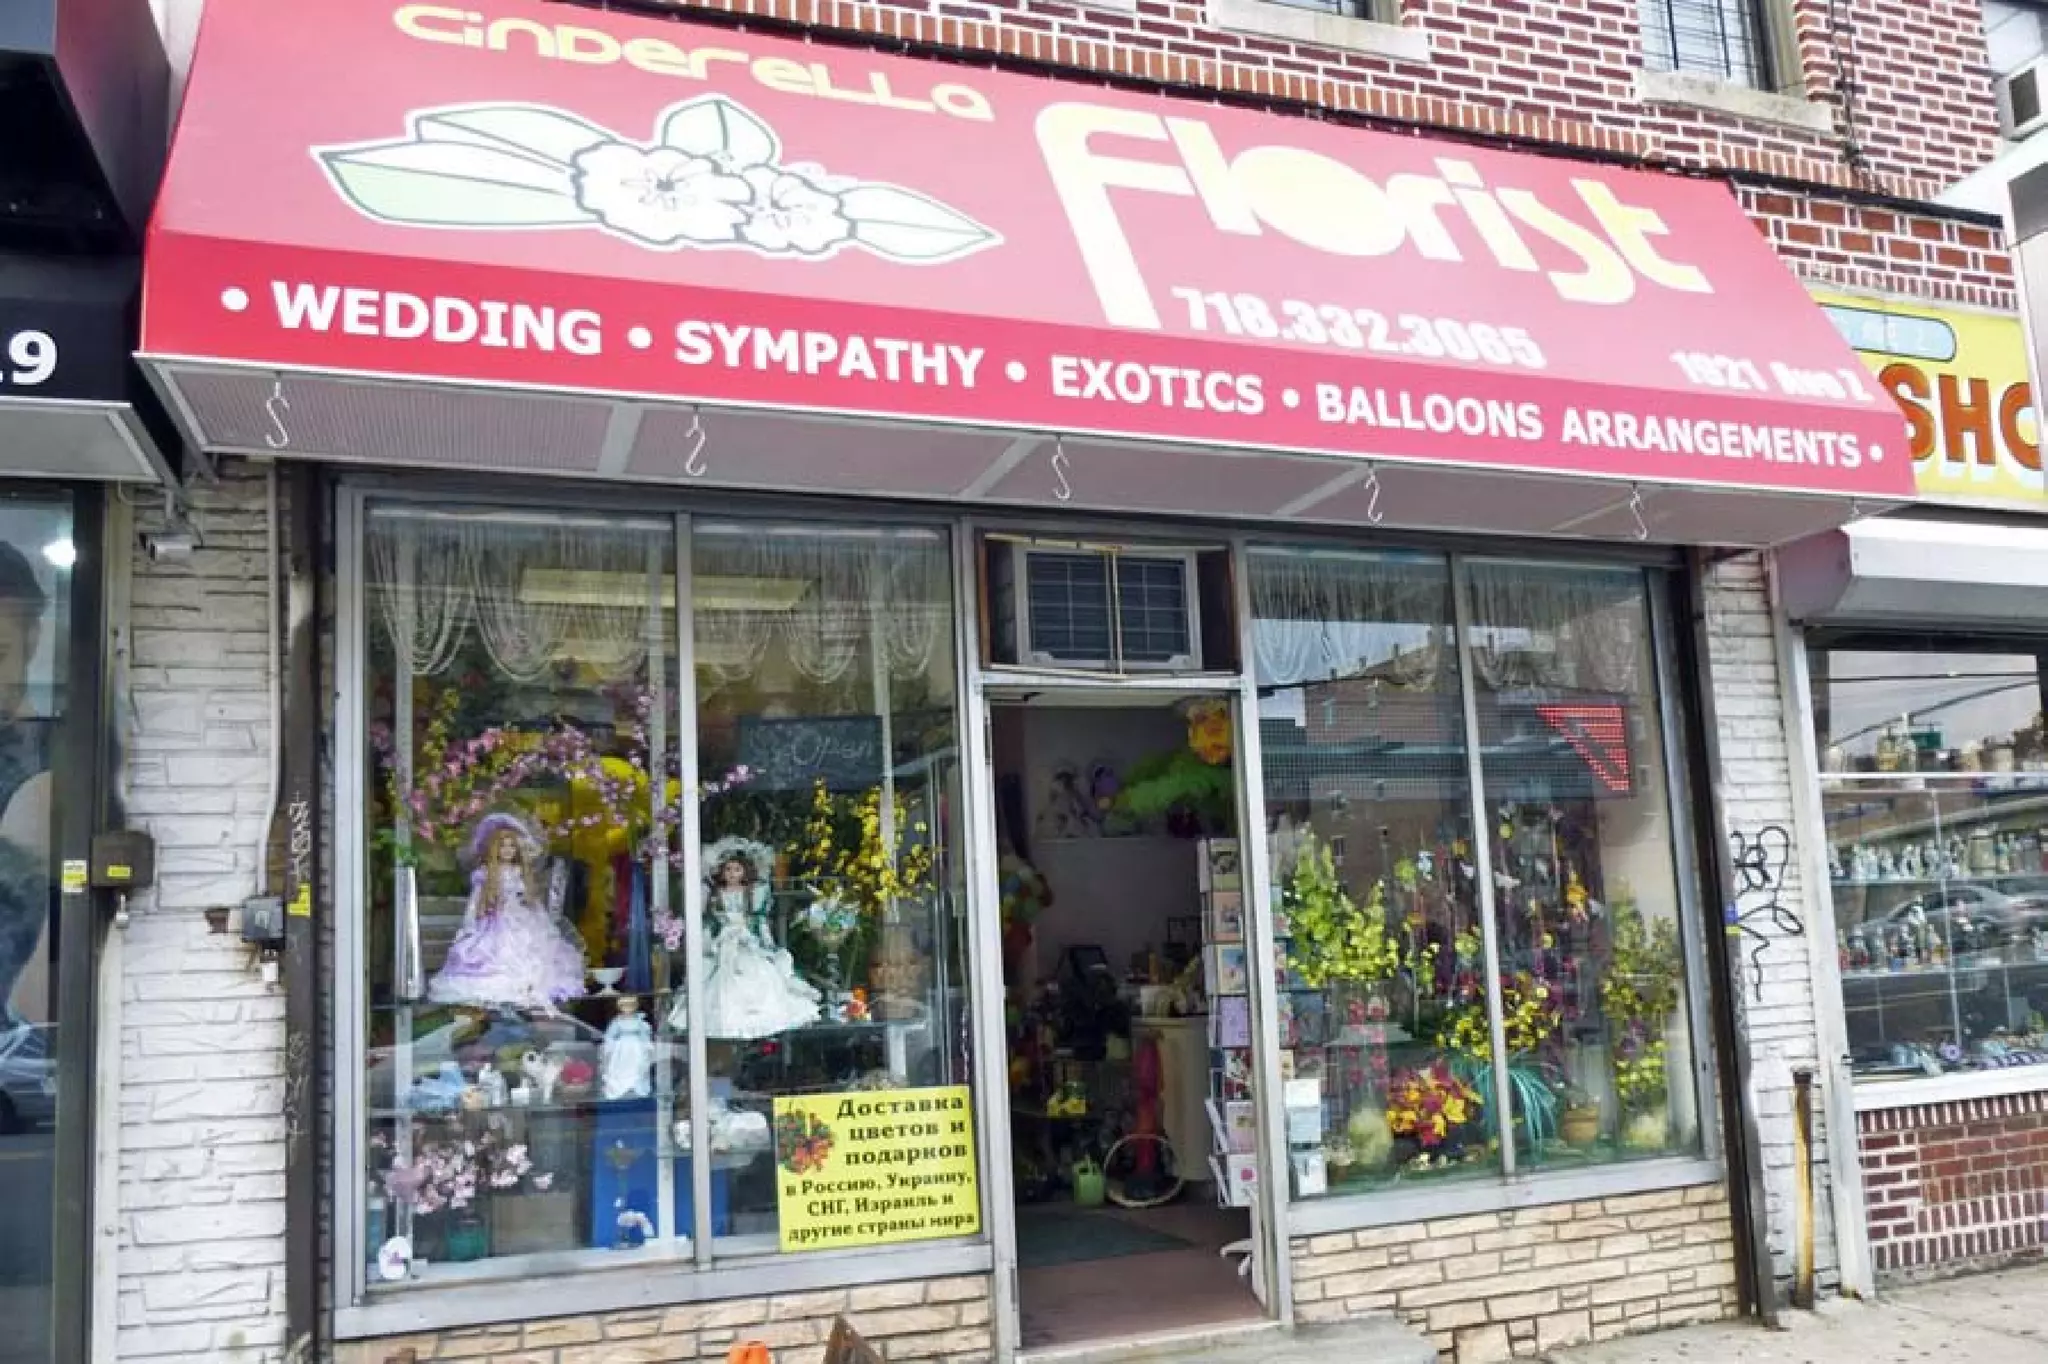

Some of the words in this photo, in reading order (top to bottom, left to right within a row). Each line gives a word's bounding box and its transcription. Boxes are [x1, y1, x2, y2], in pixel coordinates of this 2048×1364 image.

[1034, 102, 1715, 330] Florist
[1171, 286, 1547, 369] 718.332.3065
[270, 280, 602, 355] WEDDING
[674, 319, 985, 388] SYMPATHY
[1051, 353, 1264, 415] EXOTICS
[1316, 383, 1544, 440] BALLOONS
[1561, 407, 1862, 468] ARRANGEMENTS
[837, 1096, 964, 1120] Доставка
[850, 1123, 939, 1142] цветов
[950, 1120, 965, 1133] и
[845, 1144, 967, 1166] подарков
[786, 1184, 797, 1197] в
[801, 1176, 882, 1196] Россию,
[886, 1171, 973, 1190] Украину,
[807, 1199, 850, 1217] СНГ,
[854, 1194, 939, 1215] Израиль
[942, 1192, 954, 1206] и
[788, 1225, 854, 1244] другие
[857, 1216, 926, 1235] страны
[929, 1211, 975, 1229] мира
